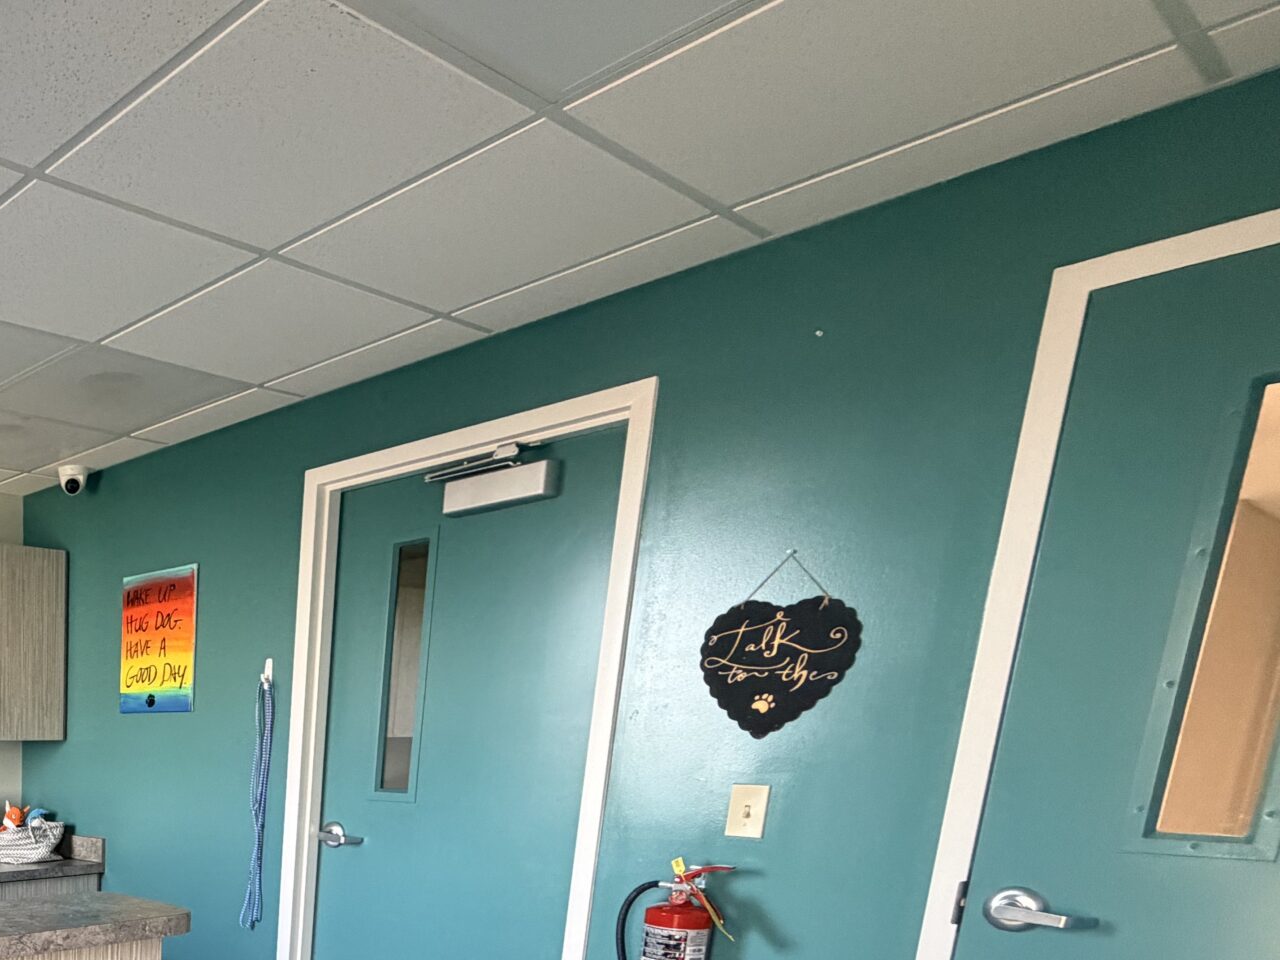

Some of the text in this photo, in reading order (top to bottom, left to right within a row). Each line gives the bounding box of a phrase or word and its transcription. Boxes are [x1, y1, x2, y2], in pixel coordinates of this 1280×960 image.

[127, 589, 152, 608] WAKE
[126, 608, 183, 635] HUG DOG.
[125, 637, 166, 661] HAVE A
[704, 611, 848, 669] Talk
[125, 662, 188, 689] GOOD DAY.
[718, 653, 838, 692] to the
